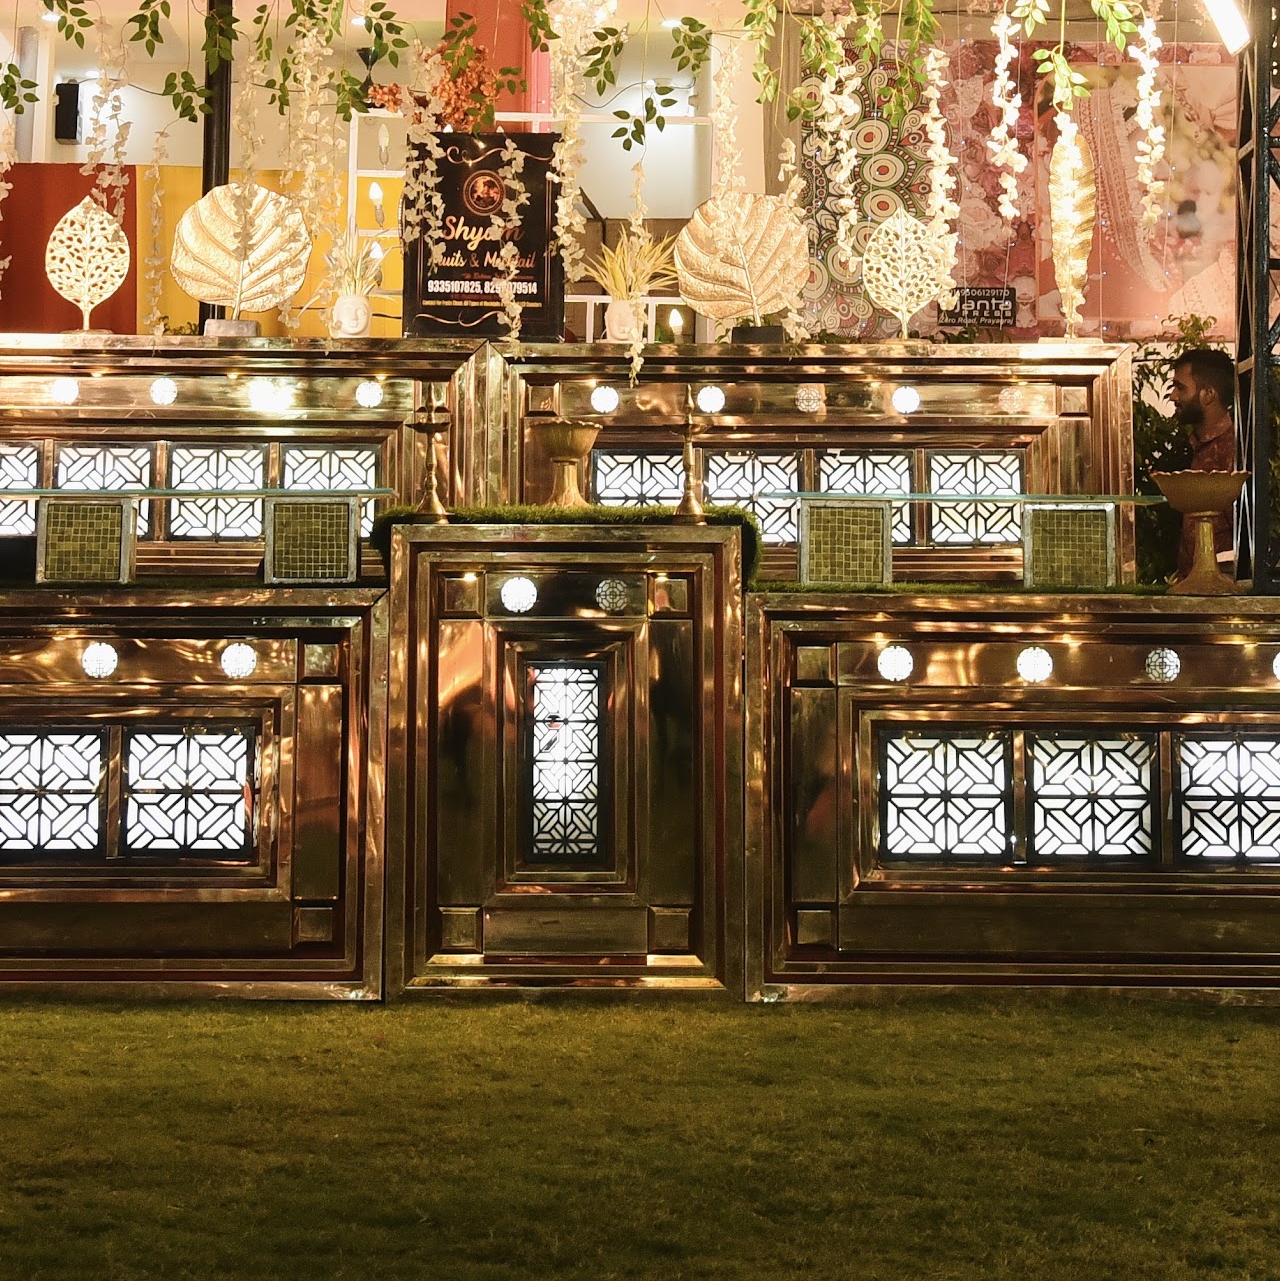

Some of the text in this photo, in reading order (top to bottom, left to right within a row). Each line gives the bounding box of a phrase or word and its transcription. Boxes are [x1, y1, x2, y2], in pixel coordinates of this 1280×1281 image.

[429, 249, 467, 268] uits
[470, 252, 480, 268] &
[428, 280, 483, 294] 9335107825,
[954, 298, 1012, 313] janta
